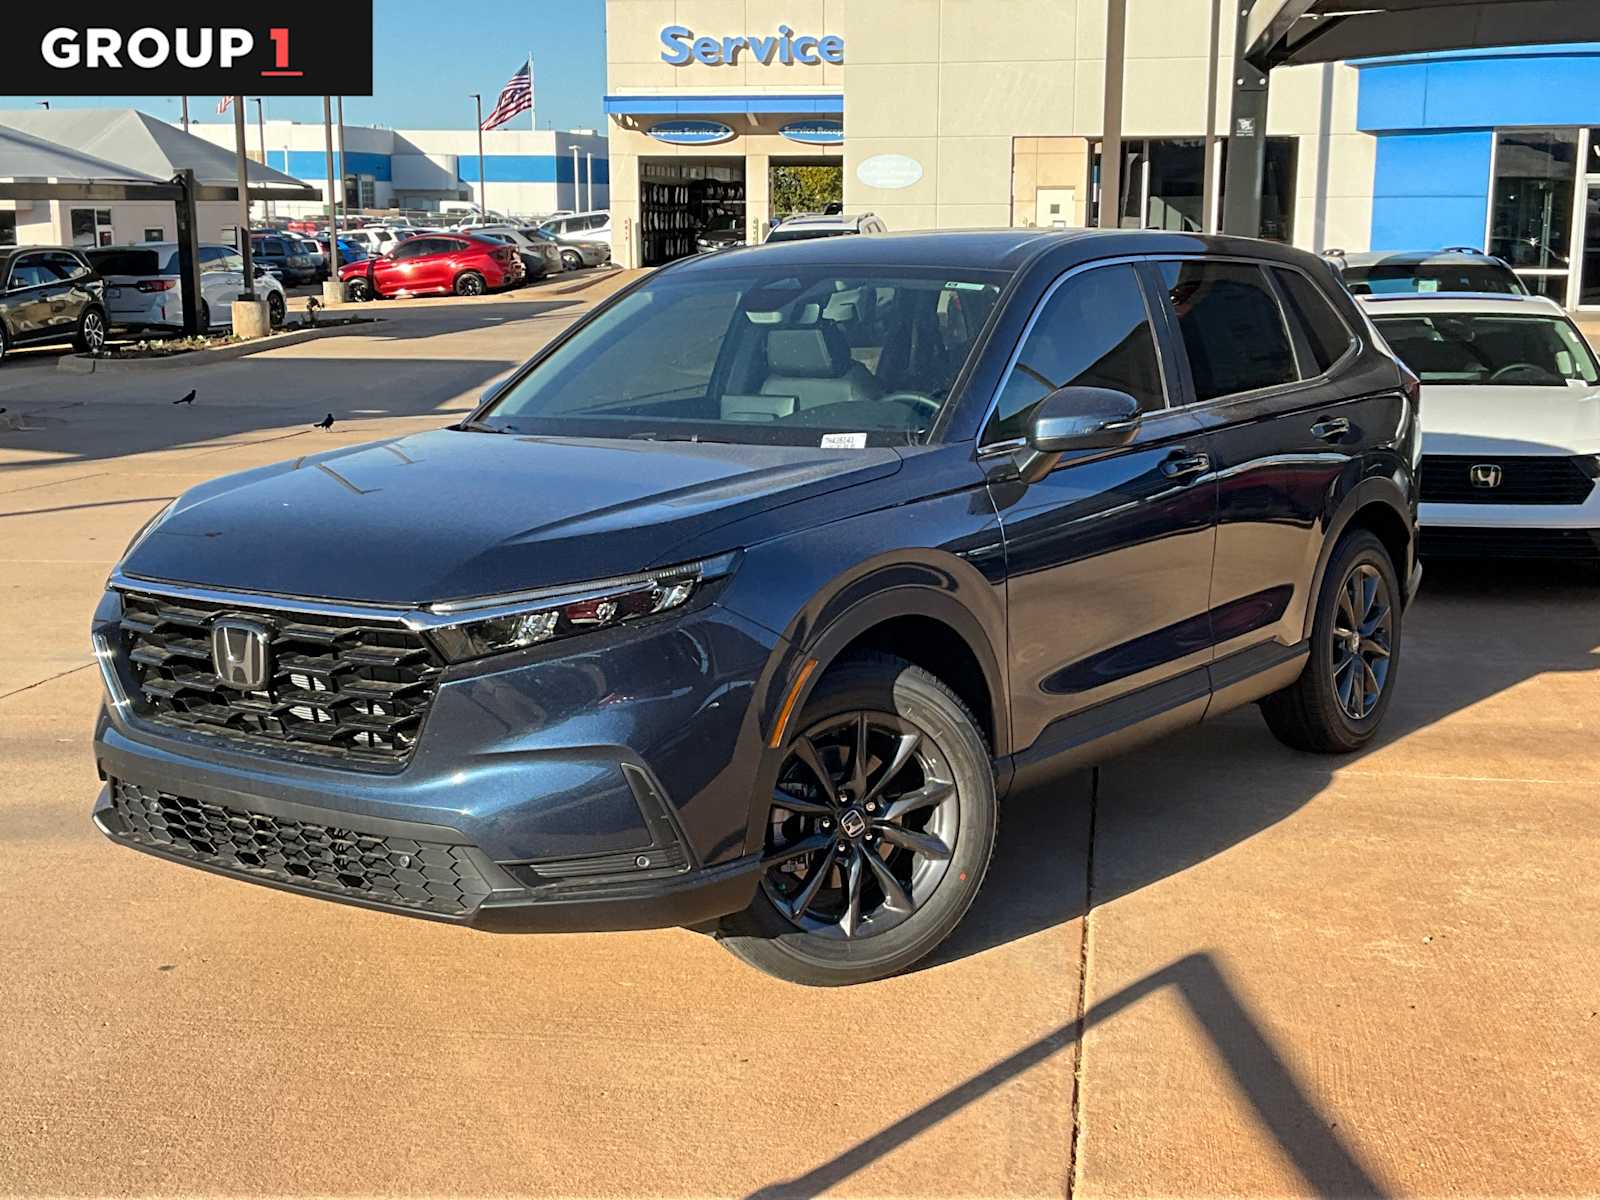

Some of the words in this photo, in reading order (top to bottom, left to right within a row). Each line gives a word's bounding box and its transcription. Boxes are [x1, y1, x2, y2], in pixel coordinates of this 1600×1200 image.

[660, 25, 845, 66] Service
[684, 127, 715, 136] Service
[784, 126, 815, 135] Service
